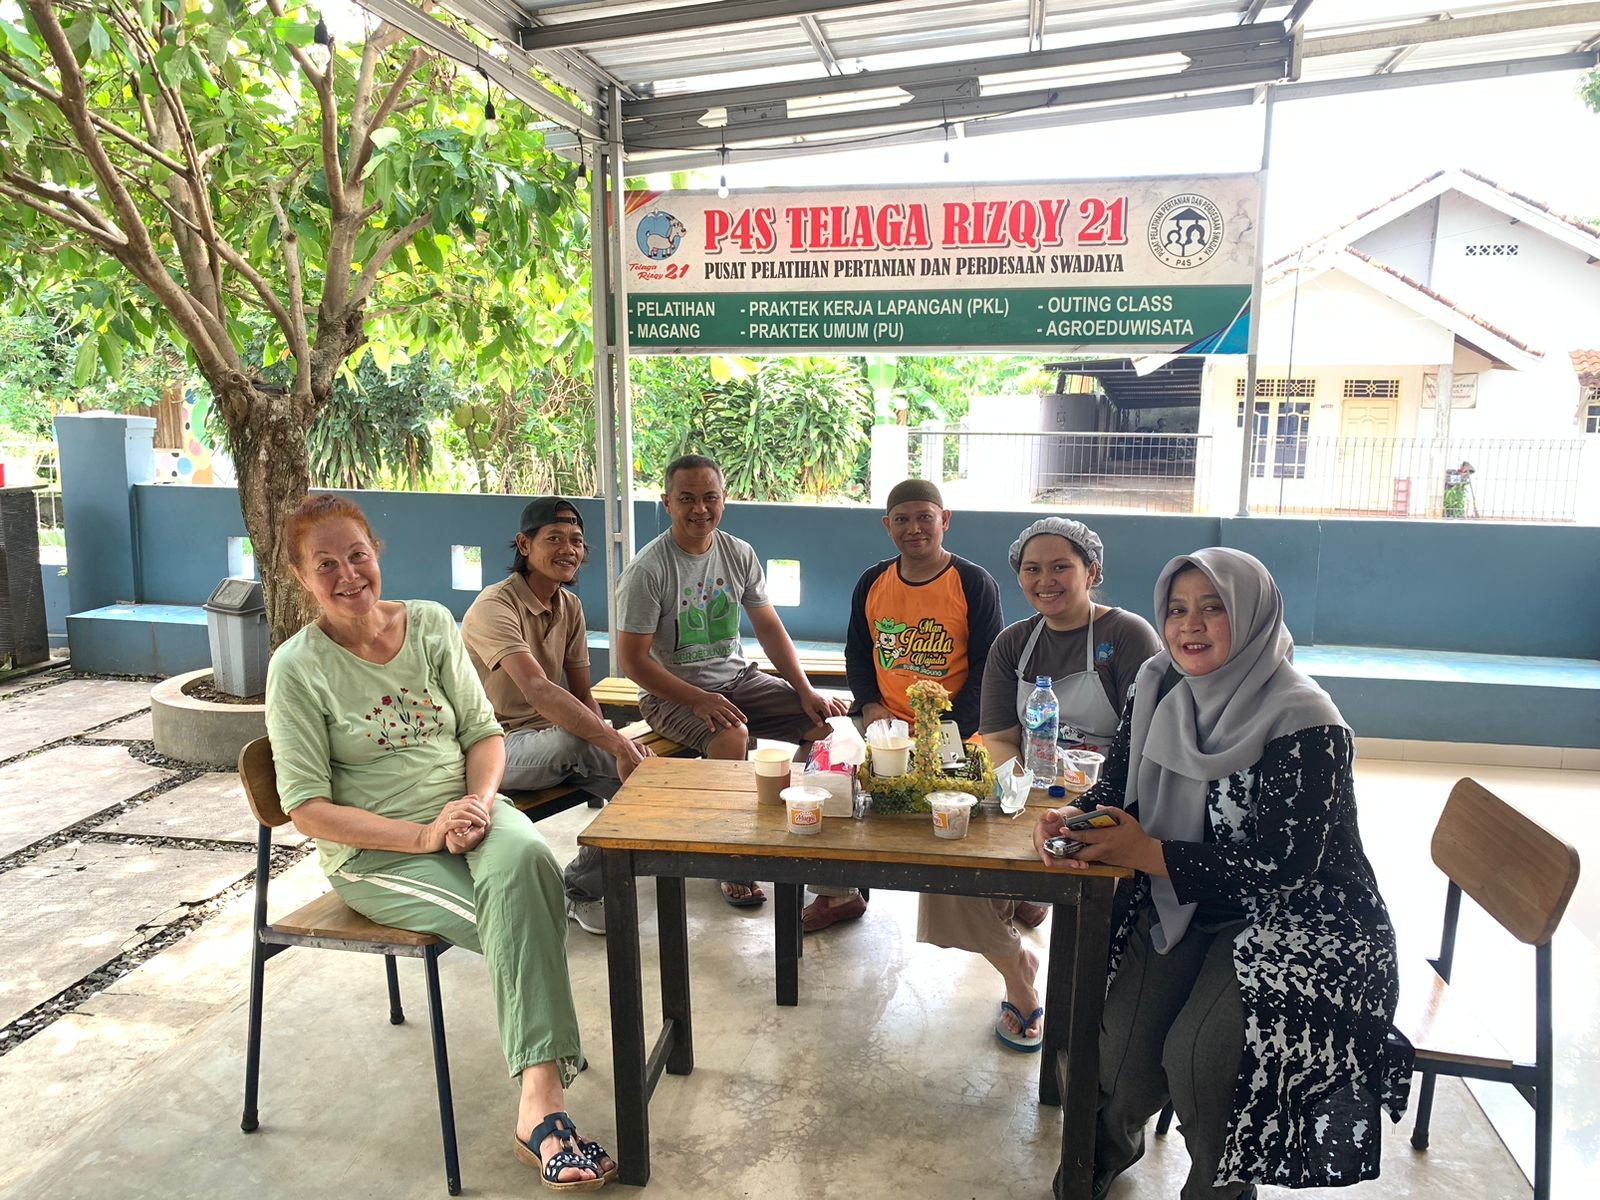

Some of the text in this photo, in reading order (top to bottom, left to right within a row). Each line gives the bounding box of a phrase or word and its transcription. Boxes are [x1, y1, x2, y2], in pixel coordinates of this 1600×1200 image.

[1161, 196, 1190, 214] PERTANIAN
[1190, 196, 1202, 206] DAN
[704, 197, 1127, 252] P4S TELAGA RIZQY 21
[1150, 211, 1165, 240] PELATIHAN
[1151, 242, 1166, 257] PUSAT
[665, 263, 690, 280] 21
[704, 254, 1124, 280] PUSAT PELATIHAN PERTANIAN DAN PERDESAAN SWADAYA
[1175, 259, 1192, 267] P4S
[637, 301, 715, 317] PELATIHAN
[750, 301, 819, 317] PRAKTEK
[823, 300, 873, 317] KERJA
[877, 299, 963, 316] LAPANGAN
[967, 297, 1009, 317] (PKL)
[1048, 297, 1112, 314] OUTING
[1116, 295, 1173, 313] CLASS
[637, 323, 701, 339] MAGANG
[750, 323, 819, 339] PRAKTEK
[823, 322, 869, 339] UMUM
[873, 322, 904, 342] (PU)
[1046, 319, 1194, 336] AGROEDUWISATA
[919, 619, 943, 634] Man
[899, 627, 953, 657] Jadda
